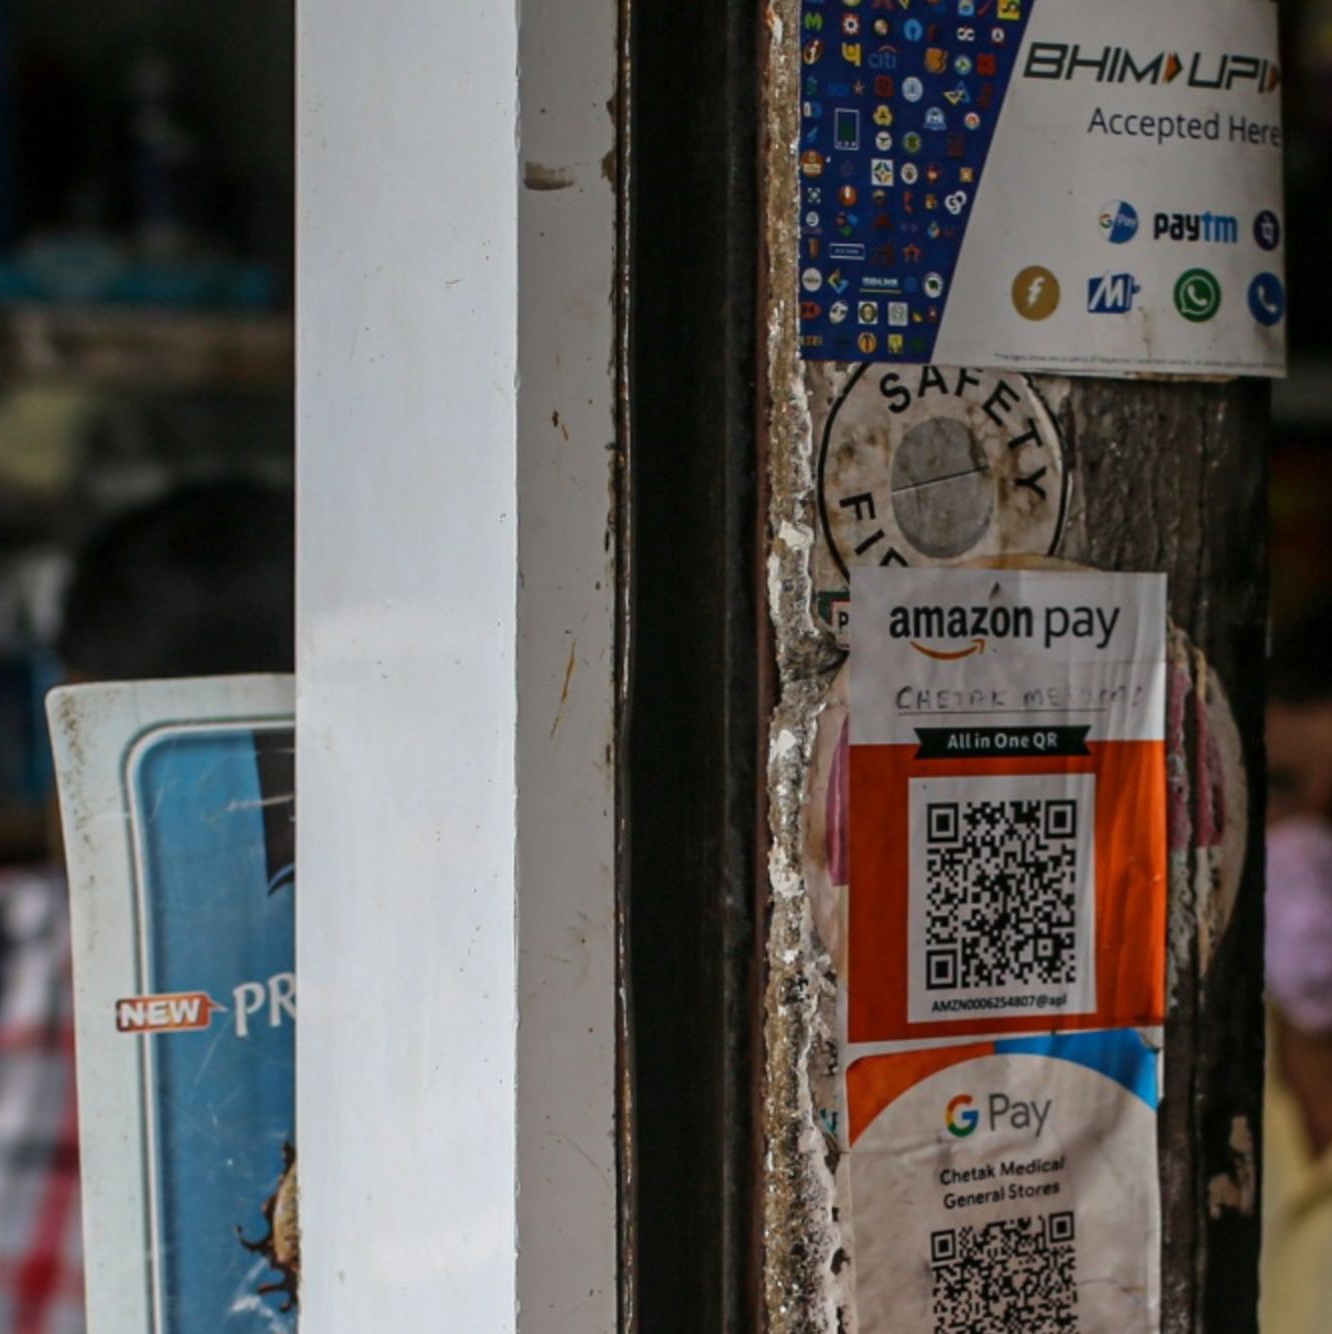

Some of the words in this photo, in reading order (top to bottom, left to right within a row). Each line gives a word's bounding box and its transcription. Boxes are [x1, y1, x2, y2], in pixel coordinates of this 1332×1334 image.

[1023, 42, 1165, 86] BHIM
[1187, 52, 1269, 94] UPI
[1087, 107, 1220, 145] Accepted
[1228, 115, 1282, 146] Here
[1153, 211, 1238, 243] paytm
[879, 365, 1047, 500] SAFETY
[890, 605, 1034, 638] amazon
[1044, 605, 1120, 649] pay
[947, 733, 971, 750] All
[975, 733, 990, 749] in
[993, 732, 1029, 749] One
[1033, 731, 1058, 749] QR
[119, 999, 202, 1028] NEW
[945, 1094, 979, 1138] G
[988, 1092, 1052, 1138] Pay
[940, 1163, 996, 1186] Chetak
[1000, 1156, 1066, 1178] Medical
[943, 1187, 1005, 1210] General
[1009, 1182, 1060, 1200] Stores
